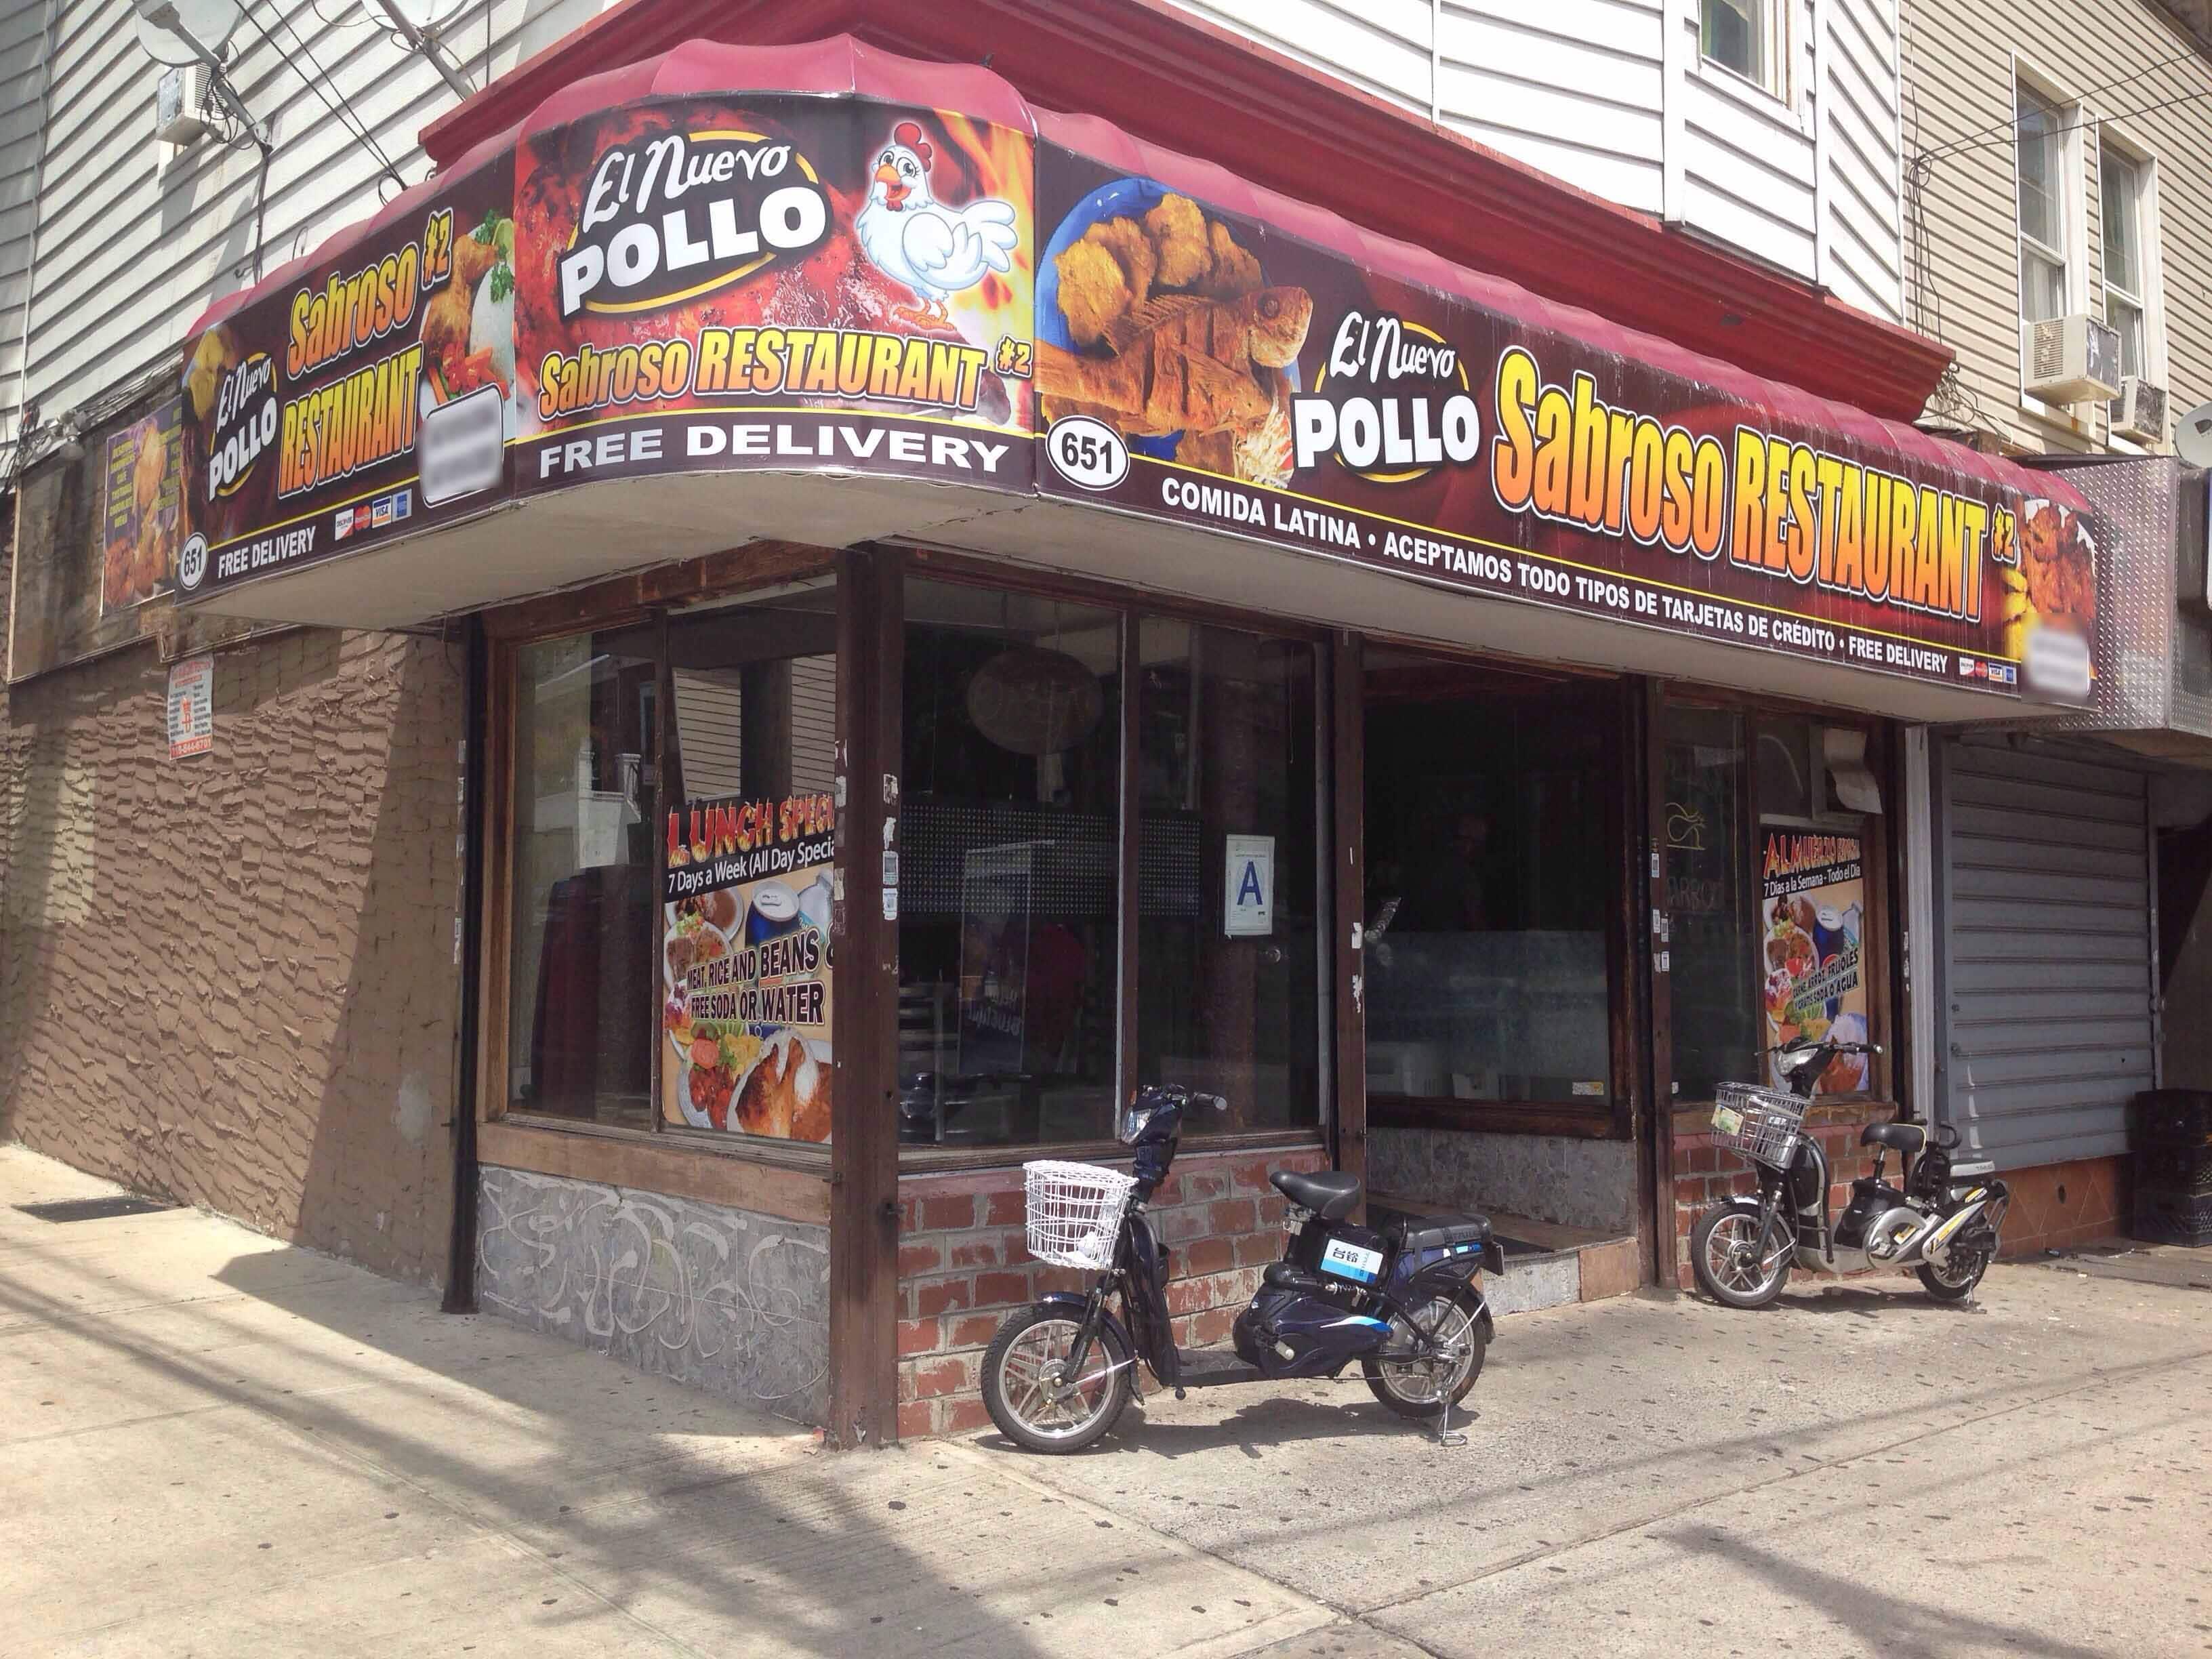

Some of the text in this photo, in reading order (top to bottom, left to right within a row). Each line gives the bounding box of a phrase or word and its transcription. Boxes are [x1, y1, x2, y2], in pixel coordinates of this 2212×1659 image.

[583, 135, 791, 233] El Nuevo
[560, 186, 826, 316] POLLO
[288, 207, 453, 380] Sabroso #2
[538, 327, 1032, 422] Sabroso RESTAURANT #2
[1330, 311, 1456, 384] El Nuevo
[217, 357, 272, 434] El Nuevo
[279, 342, 424, 499] RESTAURANT
[209, 396, 277, 502] POLLO
[539, 429, 663, 478] FREE
[687, 424, 1010, 473] DELIVERY
[1061, 432, 1113, 474] 651
[1294, 395, 1480, 468] POLLO
[375, 506, 389, 518] VISA
[1492, 345, 2017, 623] Sabroso RESTAURANT #2
[184, 546, 202, 577] 651
[218, 525, 316, 578] FREE DELIVERY
[1162, 477, 1948, 674] COMIDA LATINA ACEPTAMOS TODO TIPOS DE TARJETAS DE CRÉDITO FREE DELIVERY
[667, 792, 834, 869] LUNCH SPECI
[1763, 833, 1835, 880] ALMUERZO
[668, 874, 675, 893] 7
[678, 869, 703, 893] Days
[705, 868, 712, 884] a
[715, 856, 747, 882] Week
[749, 851, 768, 878] (All
[771, 847, 794, 873] Day
[1237, 861, 1263, 905] A
[1764, 883, 1769, 897] 7
[1786, 882, 1790, 894] a
[1791, 877, 1797, 890] la
[1798, 874, 1823, 889] Semana
[1827, 868, 1843, 882] Todo
[1844, 866, 1849, 880] el
[709, 956, 730, 987] RICE
[731, 949, 757, 984] AND
[759, 928, 820, 979] BEANS
[1830, 984, 1834, 997] O
[1837, 971, 1858, 994] AGUA
[691, 981, 825, 1025] FREE SODA OR WATER
